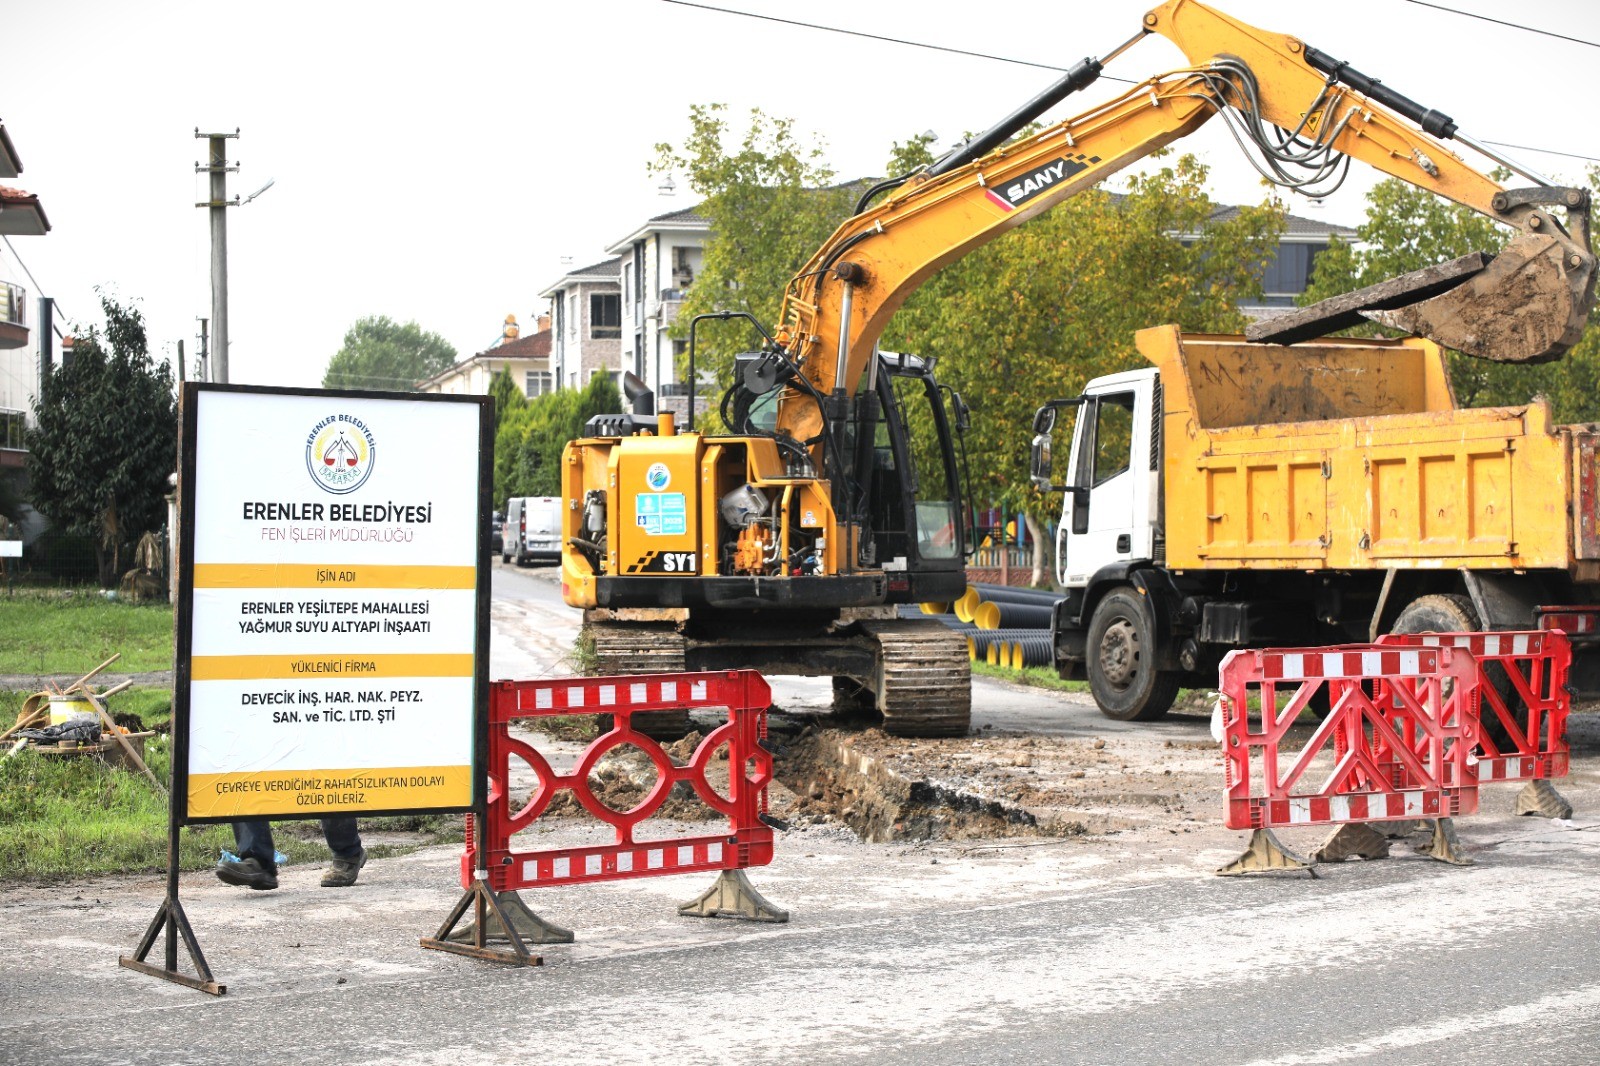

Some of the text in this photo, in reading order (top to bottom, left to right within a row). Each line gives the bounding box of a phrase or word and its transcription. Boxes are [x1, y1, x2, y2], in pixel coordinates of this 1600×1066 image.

[1007, 161, 1064, 202] SANY
[306, 414, 377, 447] ERENLER BELEDİYESİ
[243, 500, 433, 524] ERENLER BELEDİYESİ
[261, 525, 414, 544] FEN İŞLERİ MÜDÜRLÜĞÜ
[663, 552, 696, 572] SY1
[316, 568, 356, 583] İŞİN ADI
[241, 599, 430, 617] ERENLER YEŞİLTEPE MAHALLESİ
[238, 618, 431, 636] YAĞMUR SUYU ALTYAPI İNŞAATI
[290, 659, 376, 673] YÜKLENİCİ FİRMA
[241, 689, 424, 706] DEVECİK İNŞ. HAR. NAK. PEYZ.
[272, 708, 396, 725] SAN. ve TİC. LTD. ŞTİ
[215, 775, 445, 795] ÇEVREYE VERDİĞİMİZ RAHATSIZLIKTAN DOLAYI
[296, 791, 368, 806] ÖZÜR DİLERİZ.
